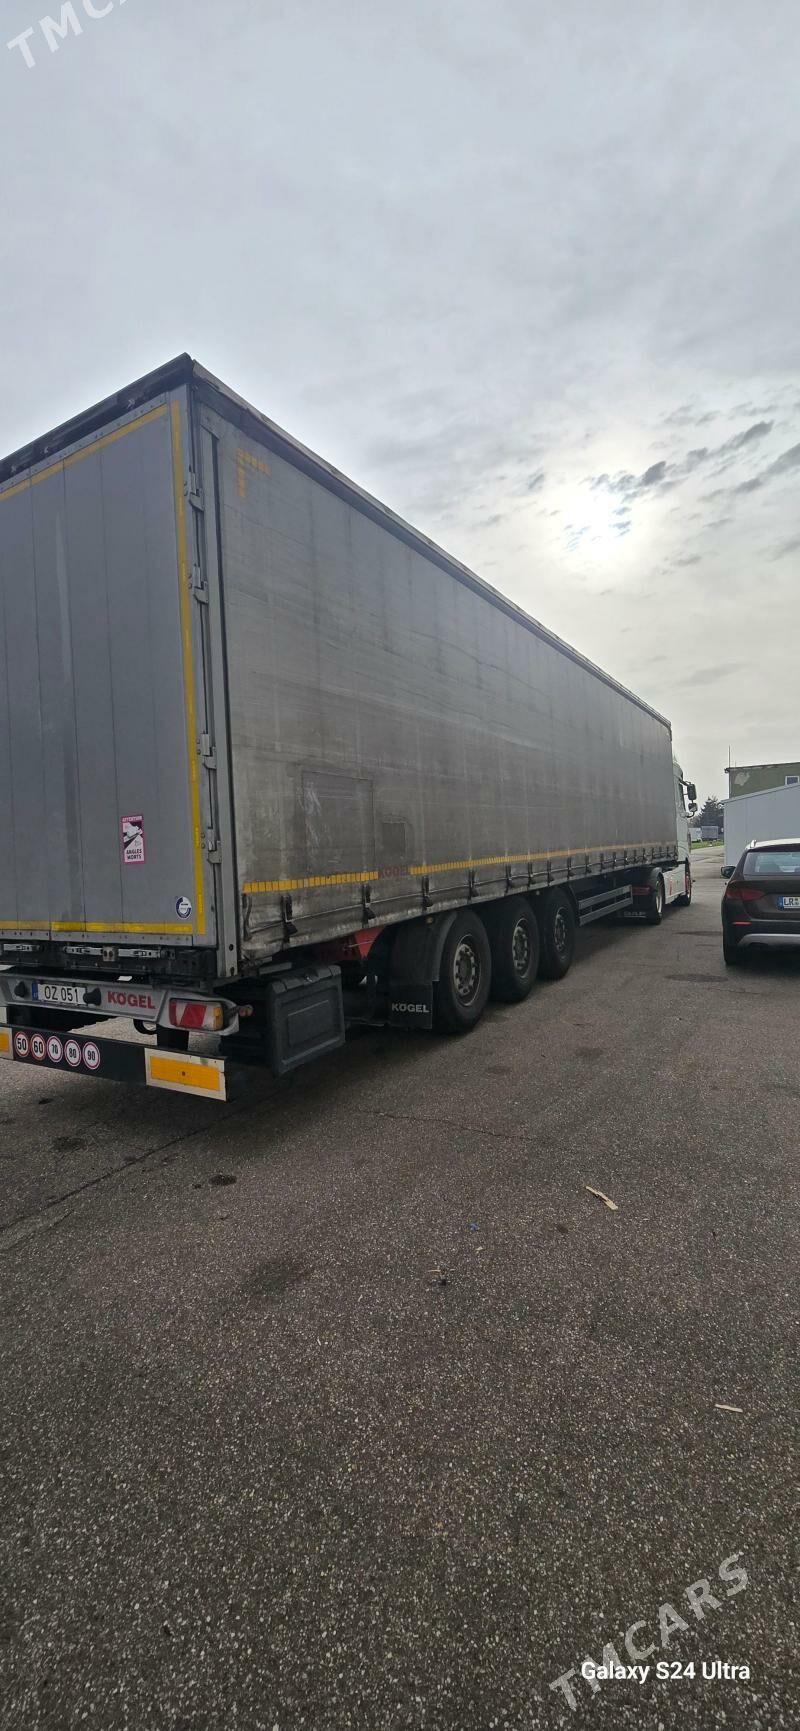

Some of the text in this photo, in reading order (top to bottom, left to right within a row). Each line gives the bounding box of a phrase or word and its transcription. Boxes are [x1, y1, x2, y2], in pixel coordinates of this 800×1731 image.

[44, 986, 58, 1000] OZ
[61, 987, 79, 1003] 051
[107, 990, 156, 1009] KÖGEL
[17, 1038, 96, 1061] 50 60 70 80 90
